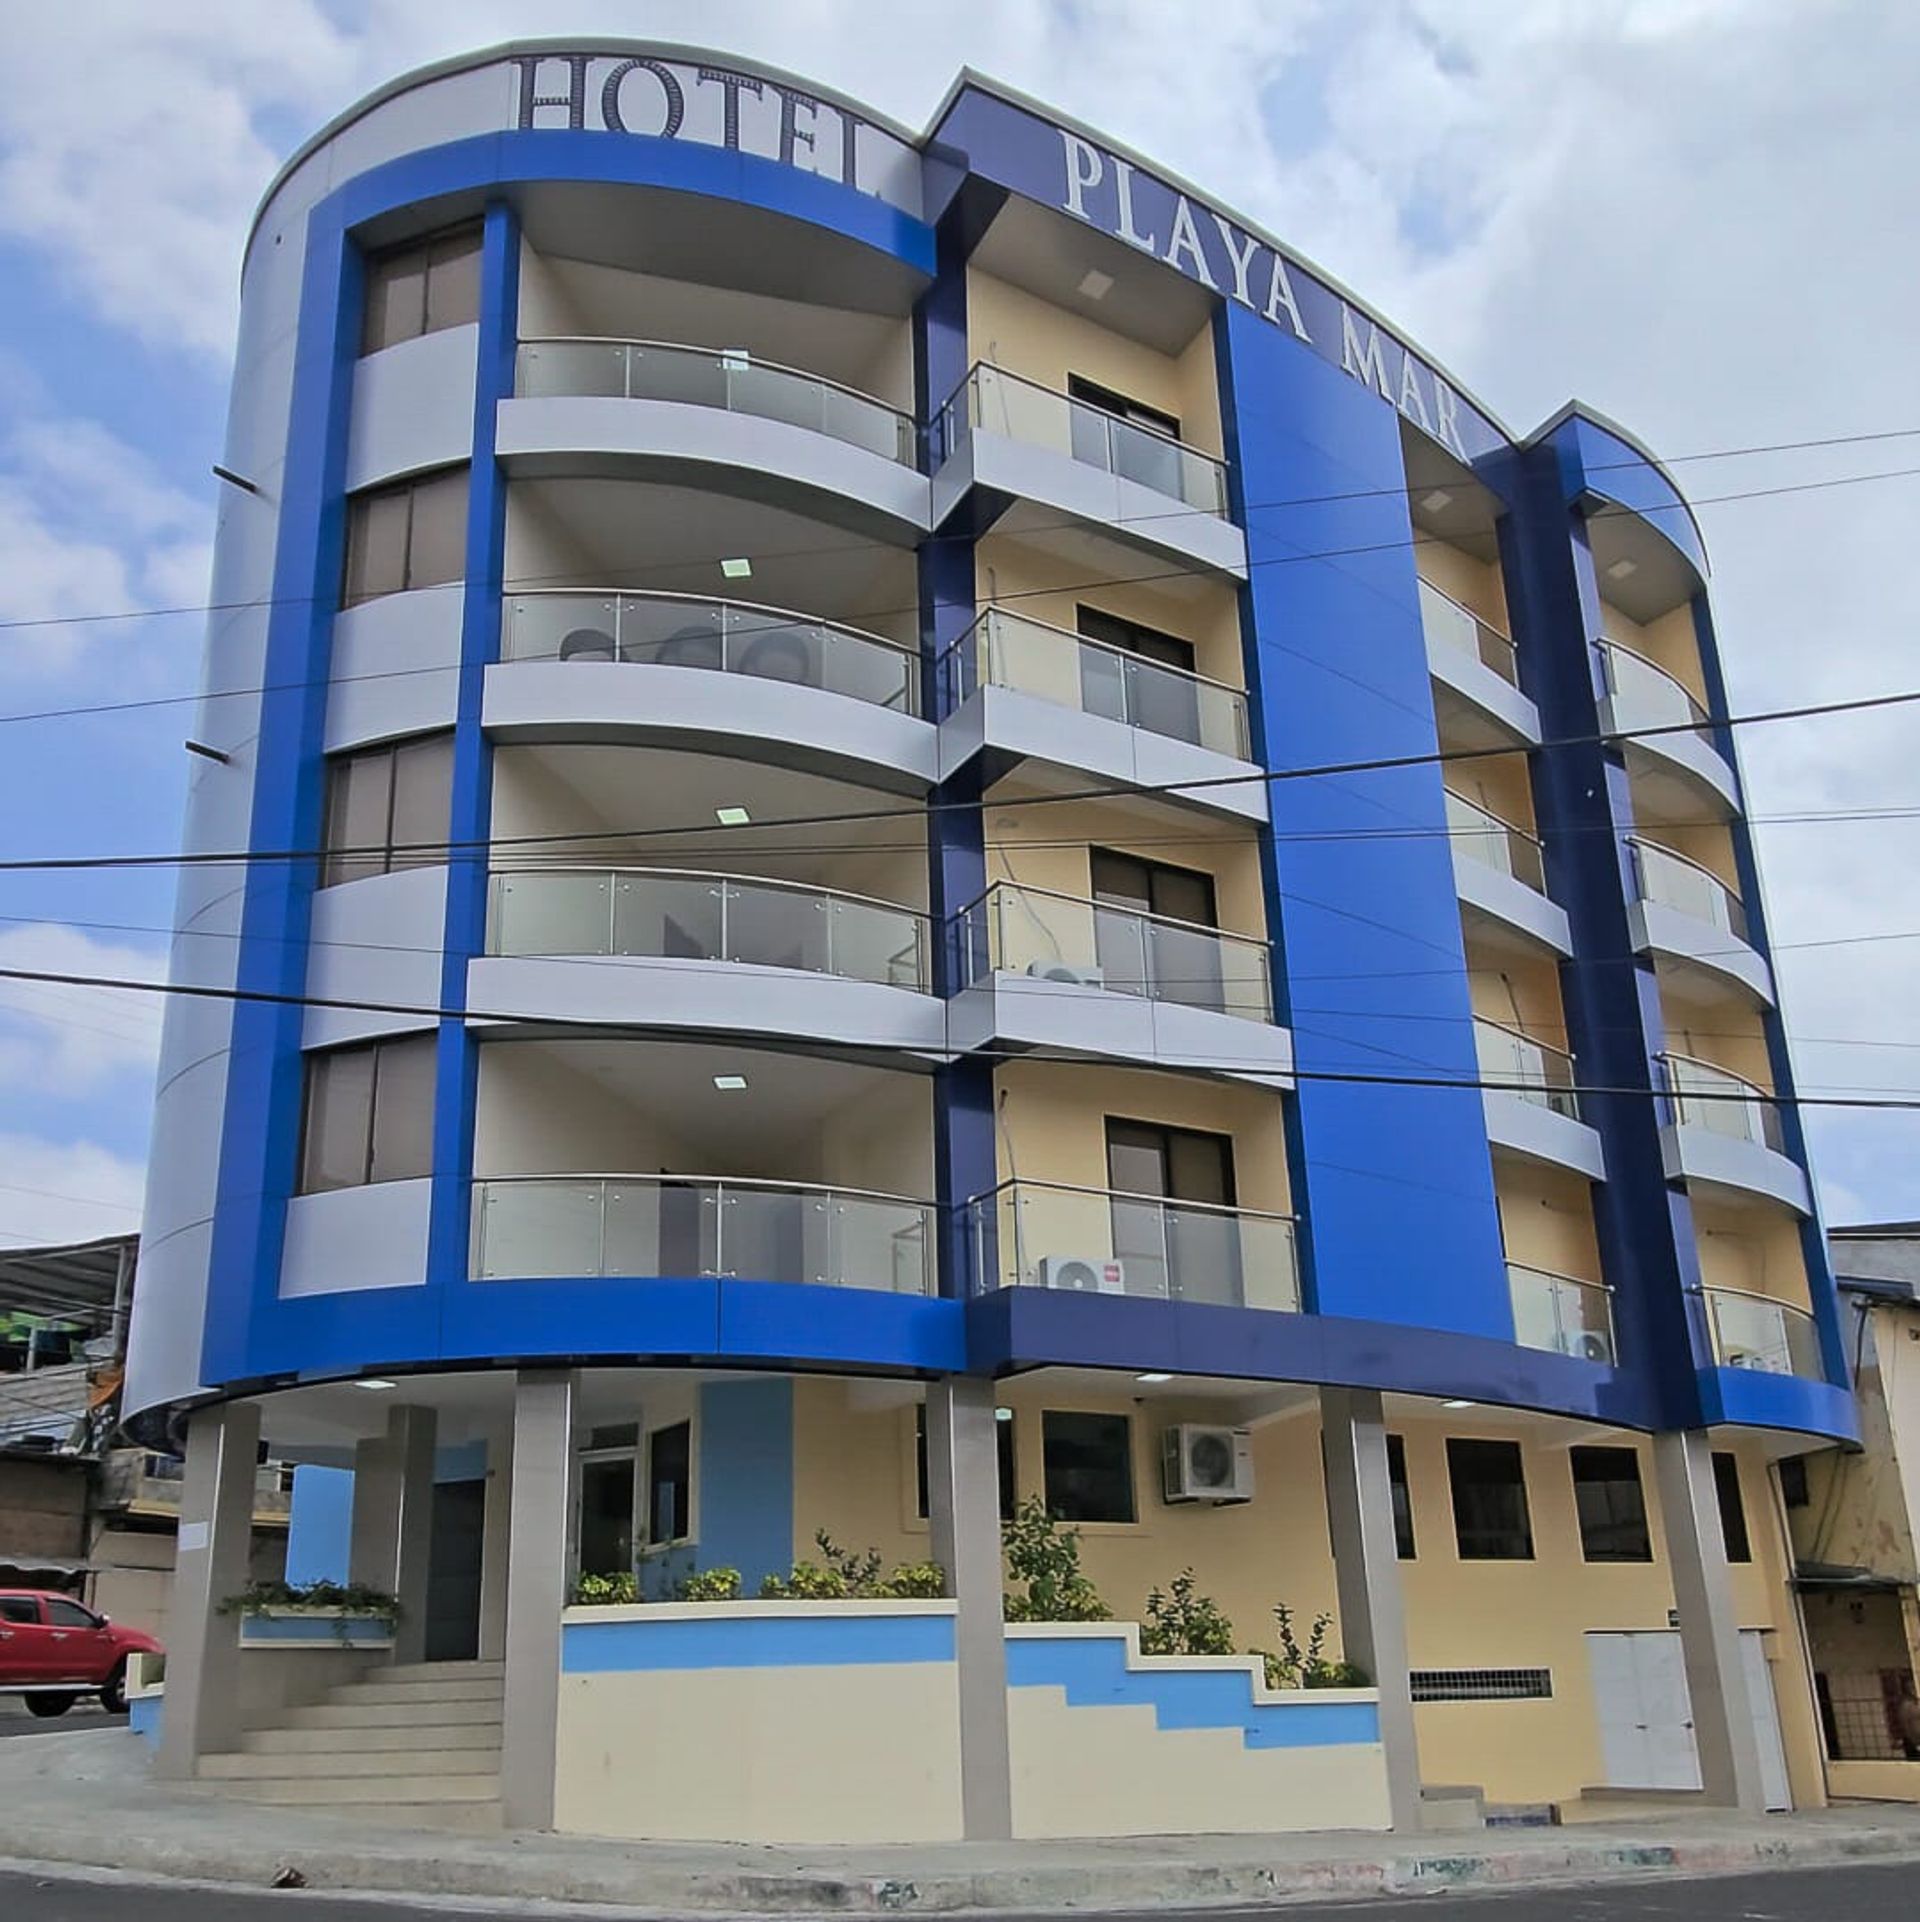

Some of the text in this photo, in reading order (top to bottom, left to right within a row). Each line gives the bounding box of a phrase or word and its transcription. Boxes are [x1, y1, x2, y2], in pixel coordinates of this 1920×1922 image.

[511, 56, 881, 199] HOTEL
[1058, 129, 1472, 466] PLAYA MAR
